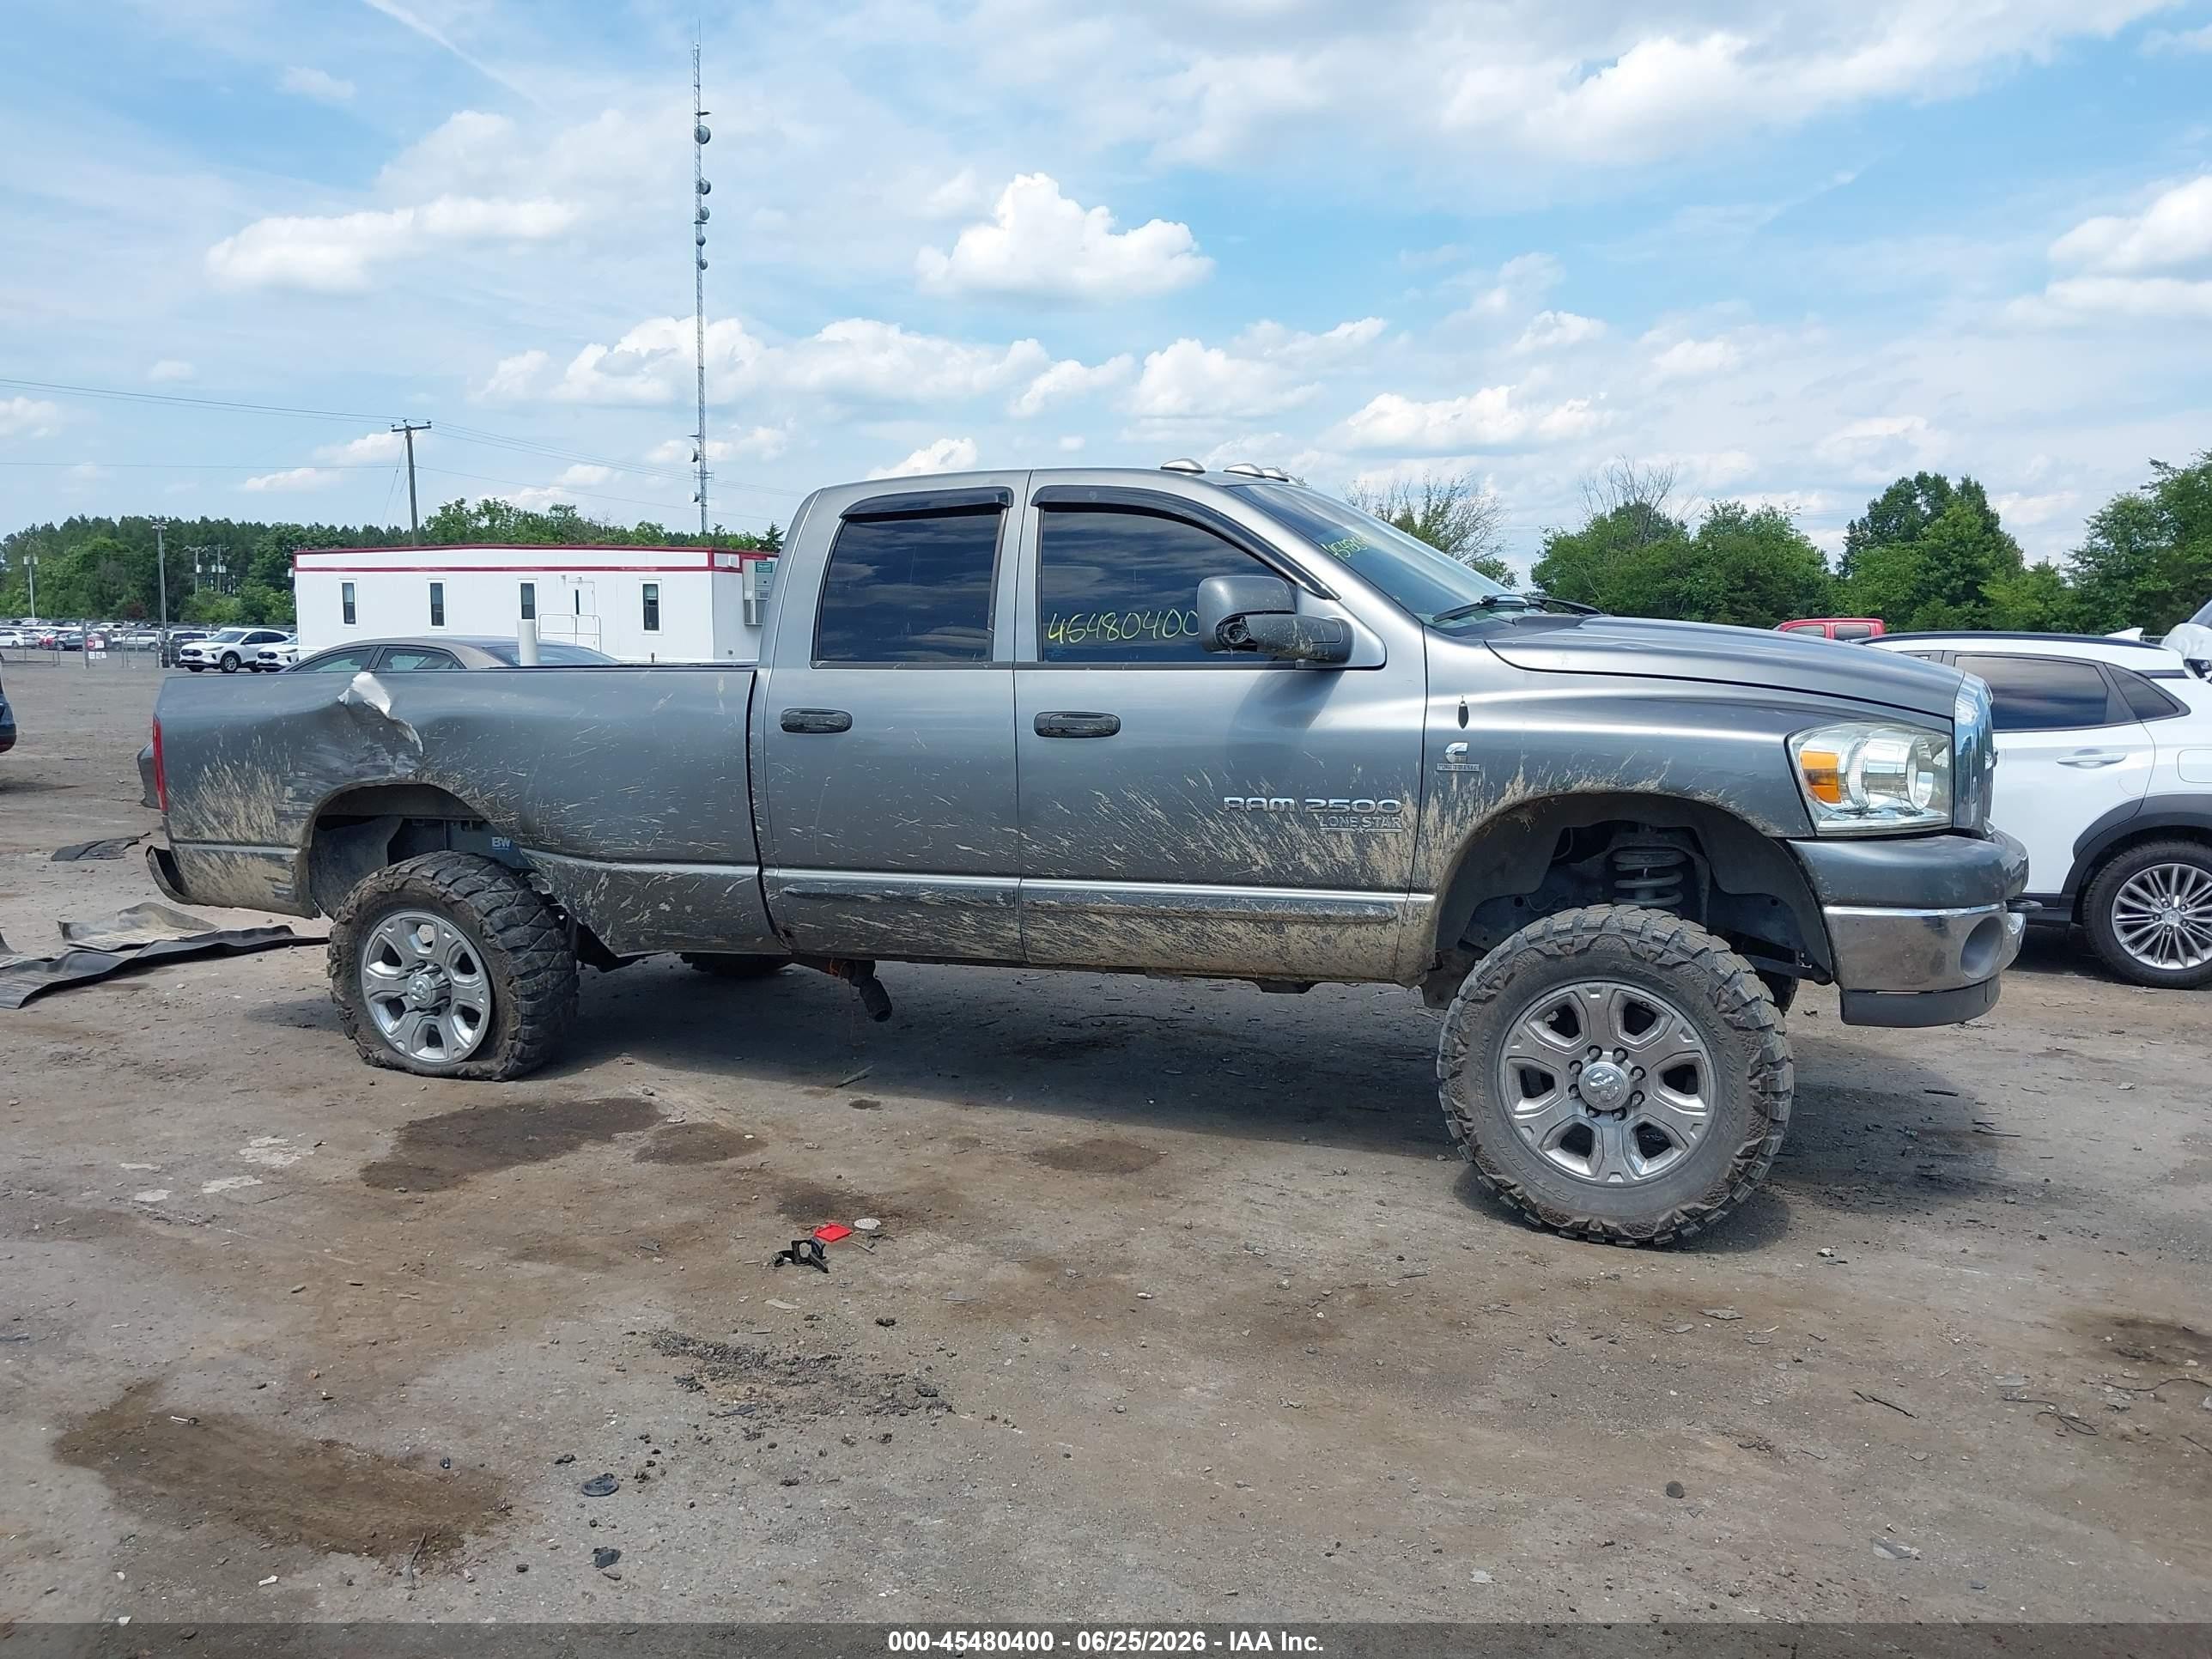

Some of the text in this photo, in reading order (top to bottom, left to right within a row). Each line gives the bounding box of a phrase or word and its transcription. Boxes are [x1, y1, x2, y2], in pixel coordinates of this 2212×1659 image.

[1048, 608, 1200, 644] 45480400
[1224, 797, 1402, 814] RAM 2500
[1319, 816, 1402, 829] LONE STAR
